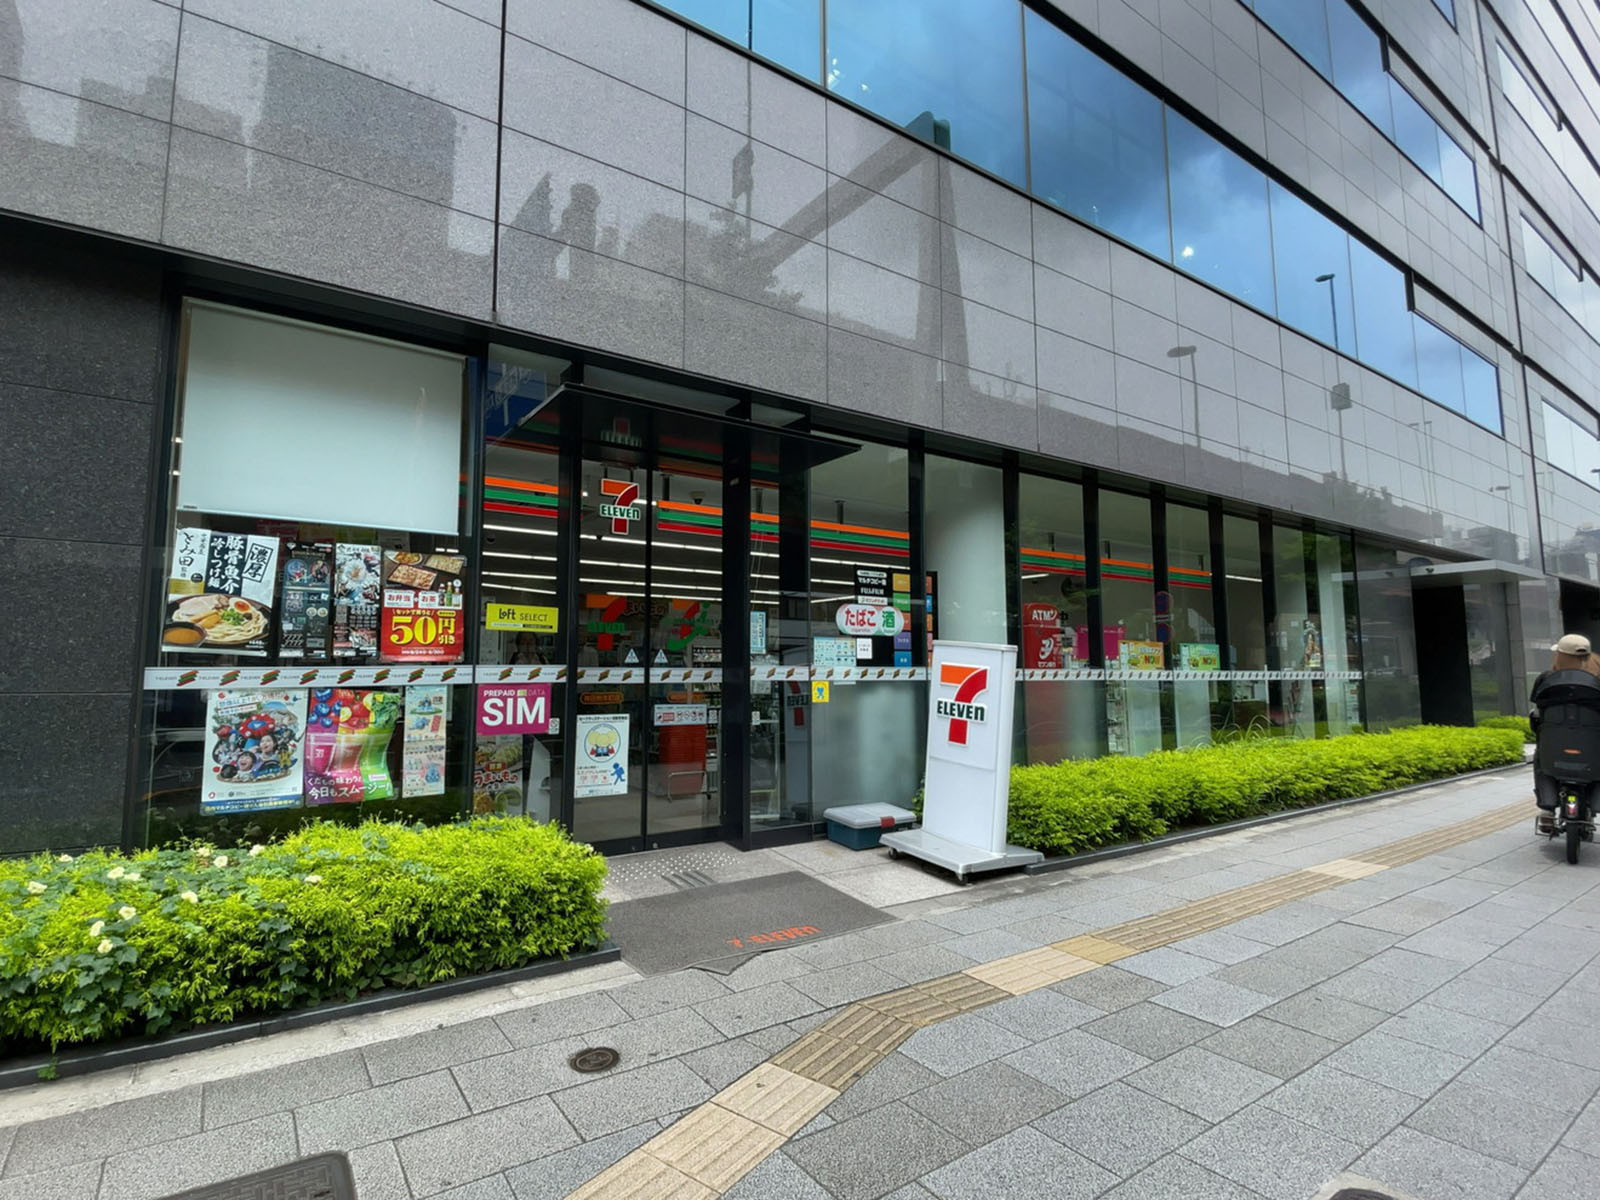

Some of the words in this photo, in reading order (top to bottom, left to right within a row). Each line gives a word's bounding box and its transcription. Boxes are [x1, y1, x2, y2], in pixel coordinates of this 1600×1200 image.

[601, 479, 639, 534] 7
[178, 532, 196, 566] とみ田
[244, 545, 270, 579] 濃厚
[220, 535, 245, 594] 豚骨魚介
[520, 613, 549, 622] SELECT
[844, 608, 877, 627] たばこ
[882, 610, 896, 628] 酒
[1032, 610, 1053, 620] ATM
[390, 616, 437, 645] 50
[483, 689, 516, 697] PREPAID
[941, 664, 988, 745] 7
[481, 697, 546, 727] SIM
